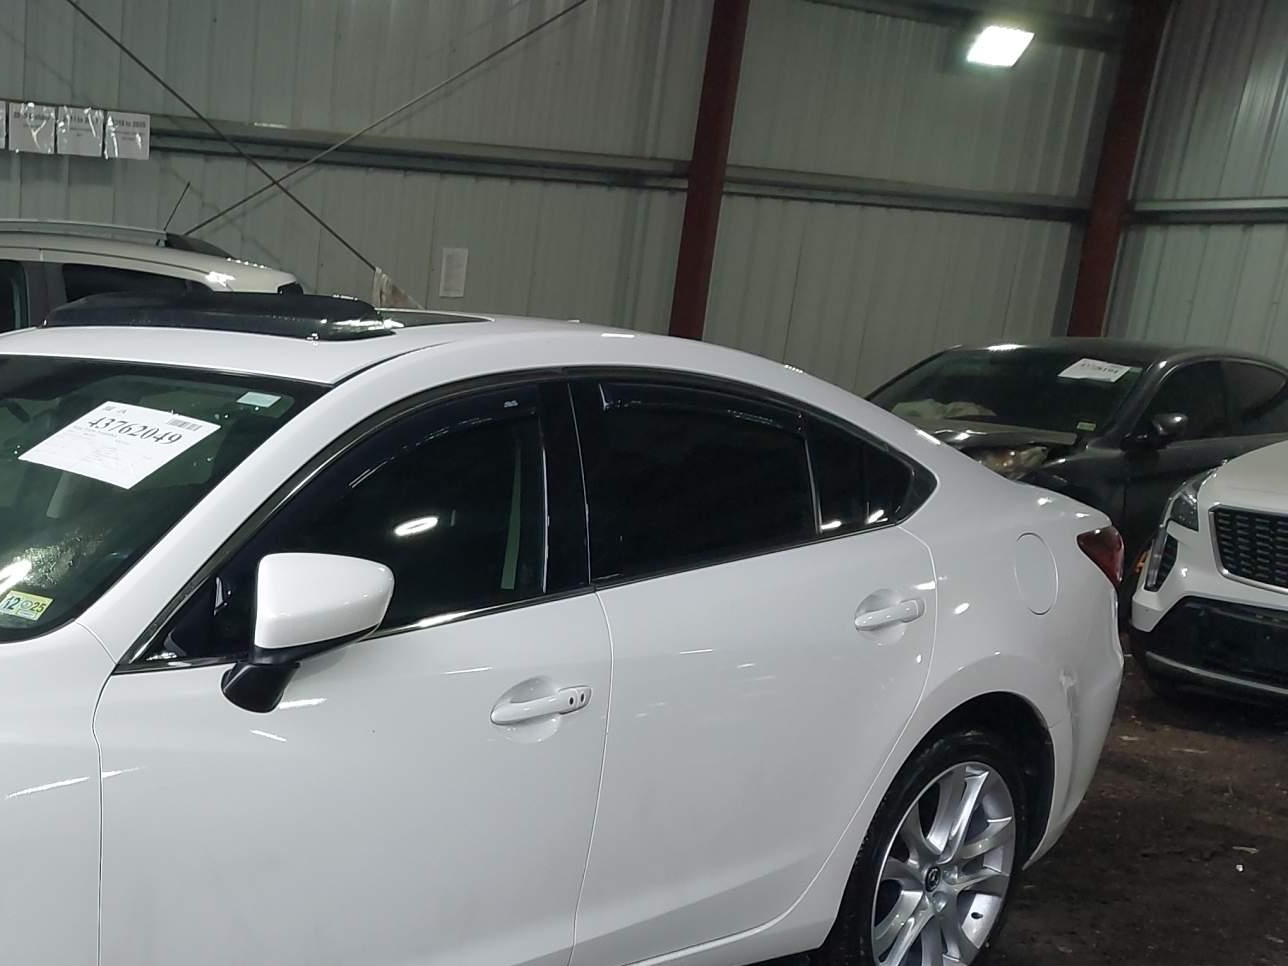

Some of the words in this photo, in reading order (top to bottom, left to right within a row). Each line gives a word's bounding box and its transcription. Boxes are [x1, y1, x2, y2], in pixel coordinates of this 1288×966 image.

[88, 416, 182, 445] 43762049
[3, 595, 21, 610] 12
[30, 601, 47, 613] 25
